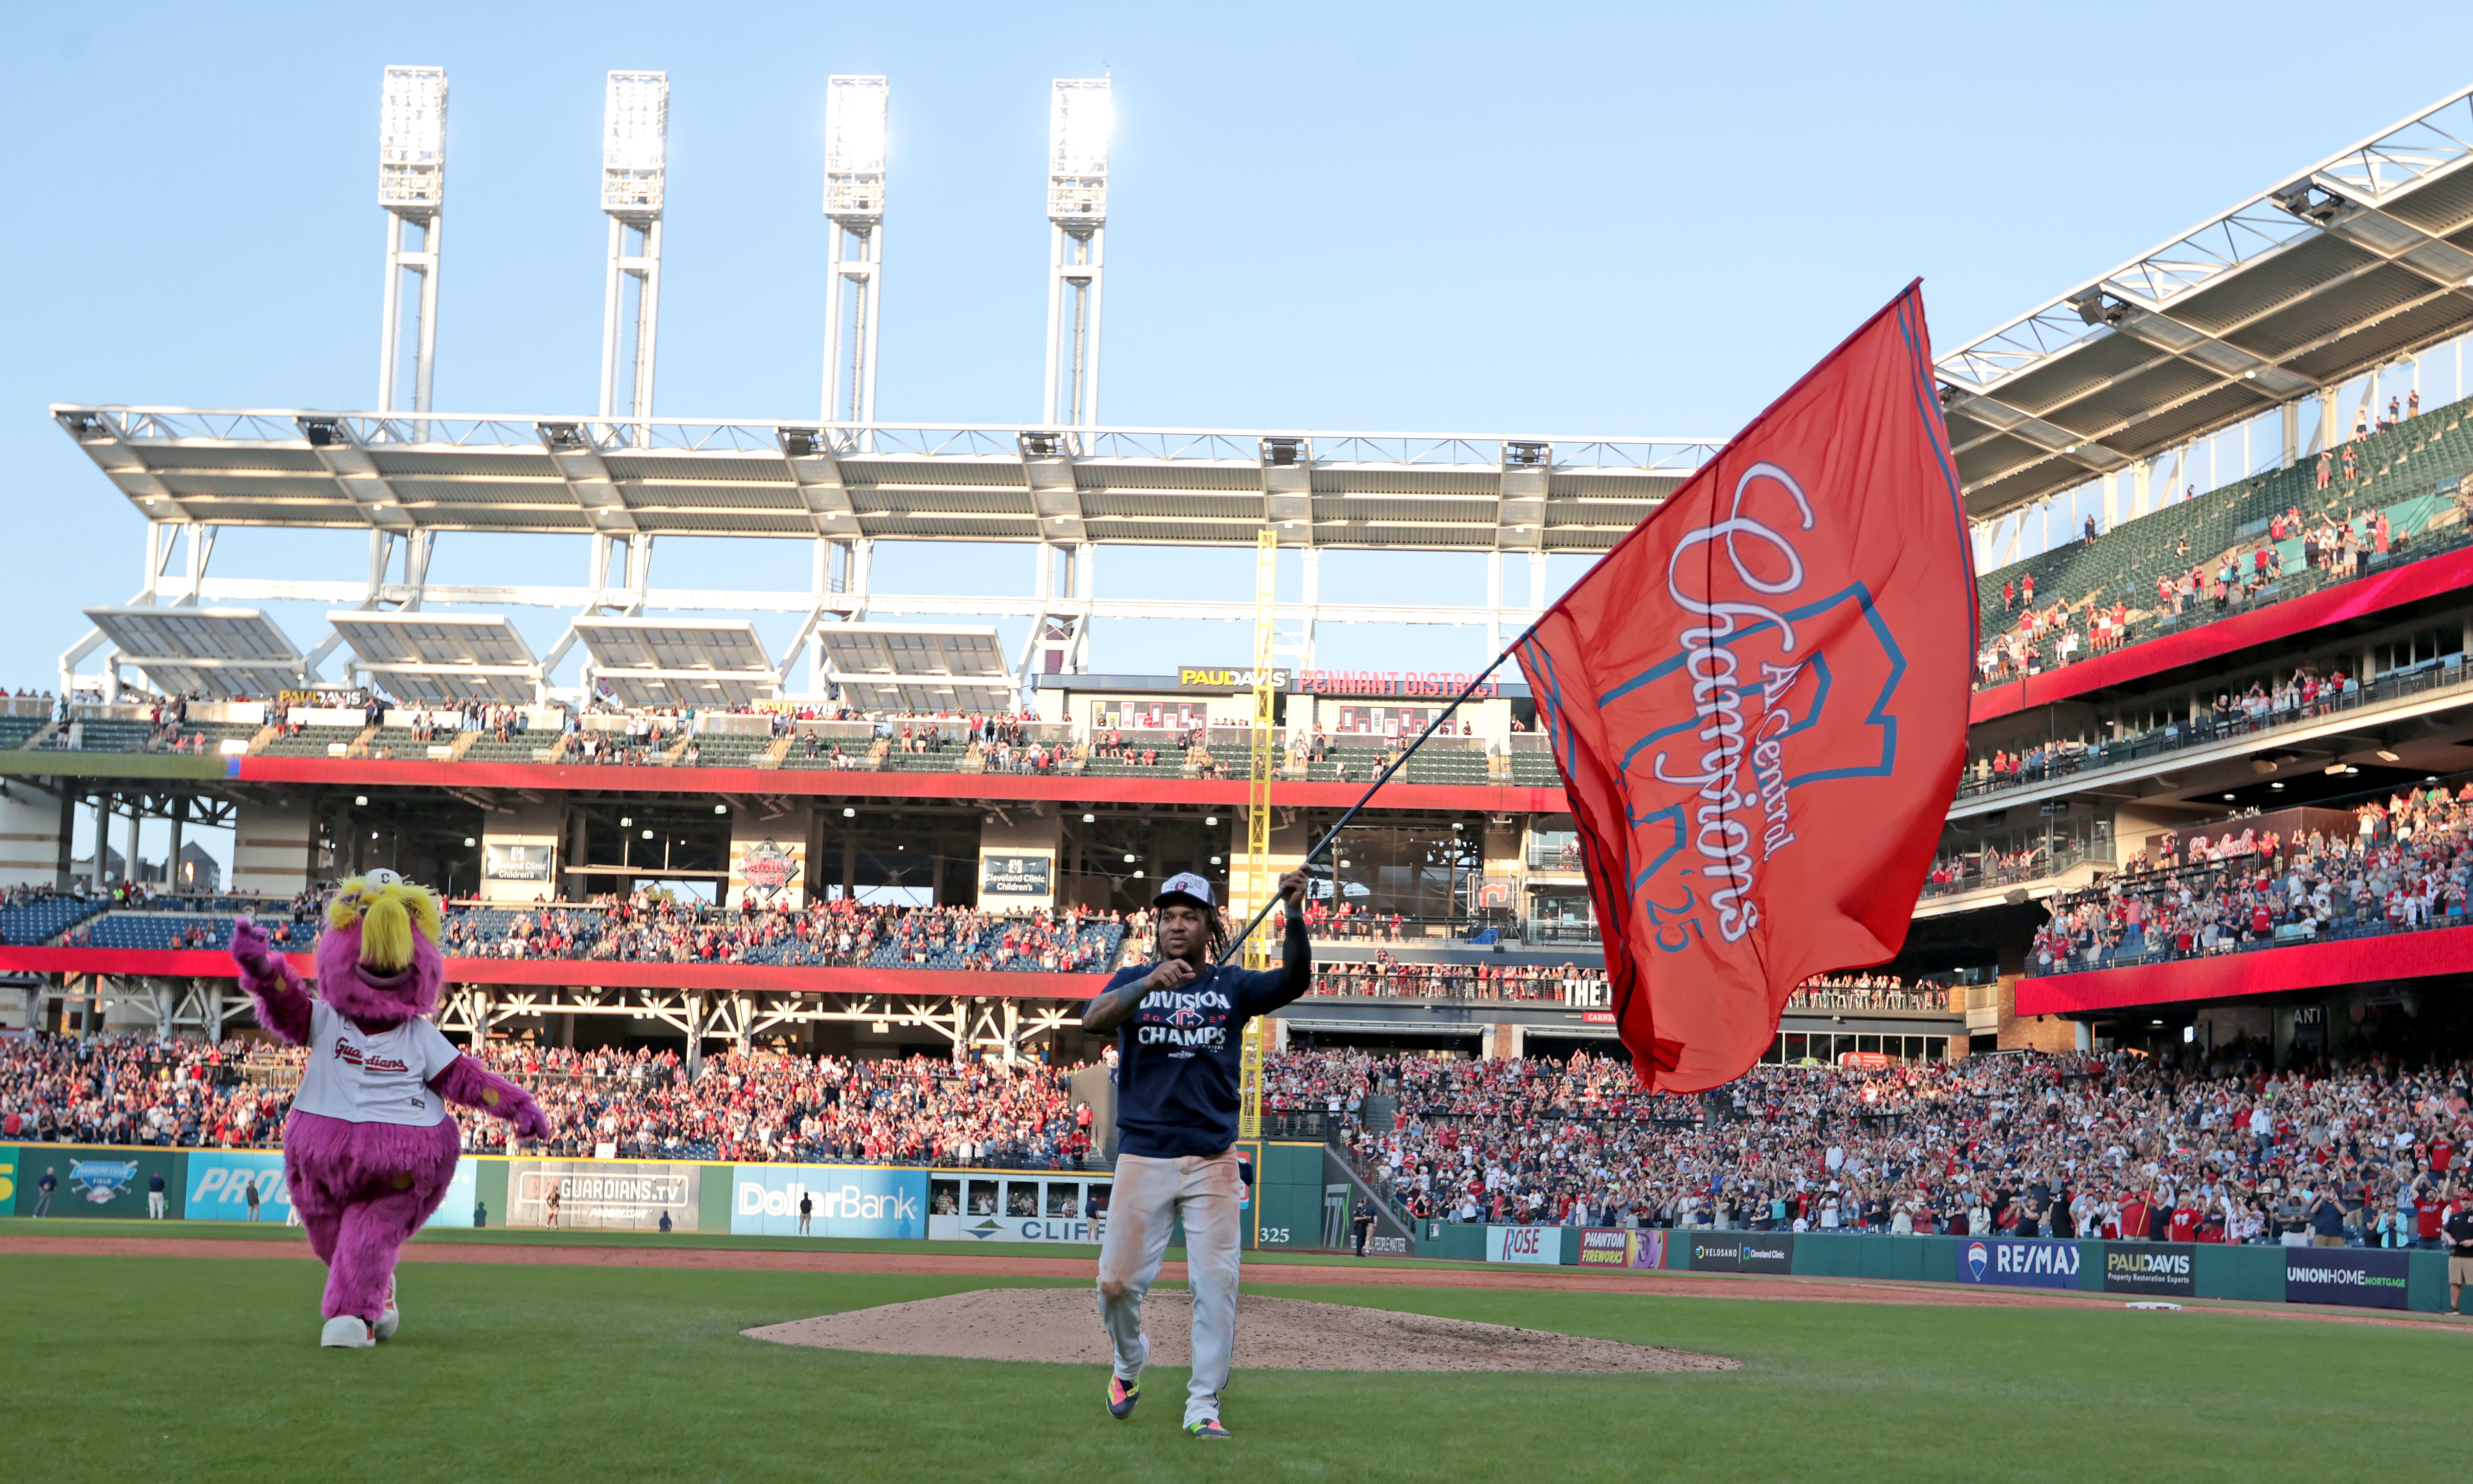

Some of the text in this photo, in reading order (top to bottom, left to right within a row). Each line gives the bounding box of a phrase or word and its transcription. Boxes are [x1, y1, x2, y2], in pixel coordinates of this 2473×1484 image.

[1298, 670, 1501, 697] PENNANT DISTRICT
[1653, 461, 1814, 943] Champions
[740, 857, 794, 872] FAMILY
[747, 872, 785, 885] DECK
[986, 873, 1045, 883] Cleveland Clinic
[997, 883, 1033, 891] Children's
[1139, 990, 1231, 1009] DIVISION
[1563, 979, 1601, 1006] THE
[1138, 1025, 1227, 1046] CHAMPS
[1259, 1228, 1290, 1243] 325
[1584, 1232, 1626, 1248] PHANTOM
[1502, 1229, 1541, 1261] ROSE
[1581, 1249, 1624, 1264] FIREWORKS
[1705, 1248, 1785, 1259] VELOSANO Cleveland Clinic
[1997, 1244, 2080, 1275] RE/MAX
[2108, 1272, 2190, 1285] Property Restoration Experts
[2365, 1277, 2405, 1288] MORTGAGE
